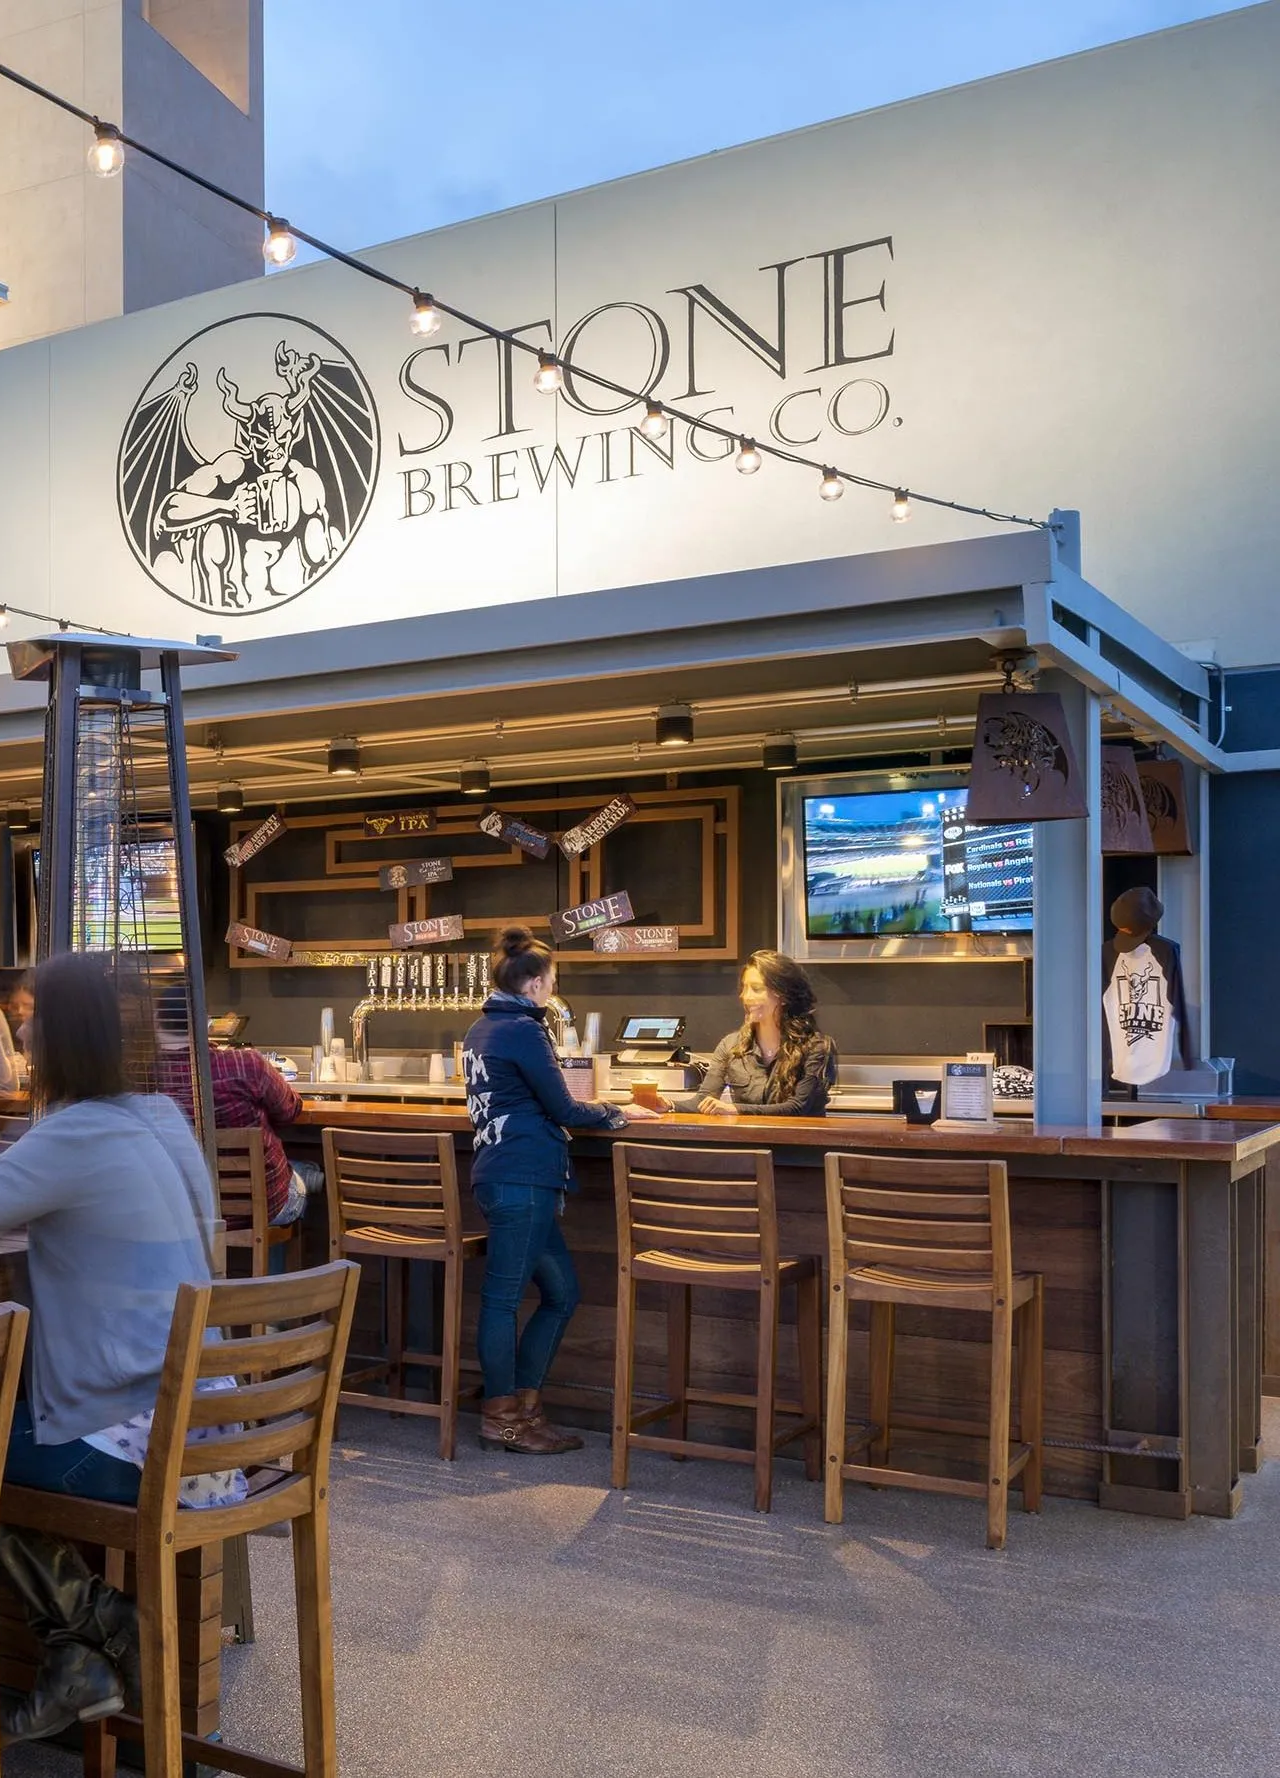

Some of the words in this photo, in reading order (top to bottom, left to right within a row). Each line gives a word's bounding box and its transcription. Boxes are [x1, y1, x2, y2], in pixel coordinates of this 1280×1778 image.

[397, 235, 896, 458] STONE
[396, 406, 736, 520] BREWING
[768, 378, 904, 447] CO.
[400, 819, 429, 831] IPA
[581, 798, 622, 841] ARROGANT
[966, 842, 1002, 853] Cardinals
[1004, 840, 1016, 848] vs
[421, 860, 441, 868] STONE
[944, 863, 965, 876] FOX
[967, 861, 992, 872] Royals
[993, 860, 1003, 868] vs
[1004, 856, 1033, 866] Angels
[968, 880, 1002, 890] Nationals
[1003, 878, 1013, 886] vs
[562, 896, 623, 935] STONE
[241, 927, 280, 953] STONE
[404, 918, 450, 942] STONE
[634, 928, 673, 944] STONE
[368, 961, 377, 987] IPA
